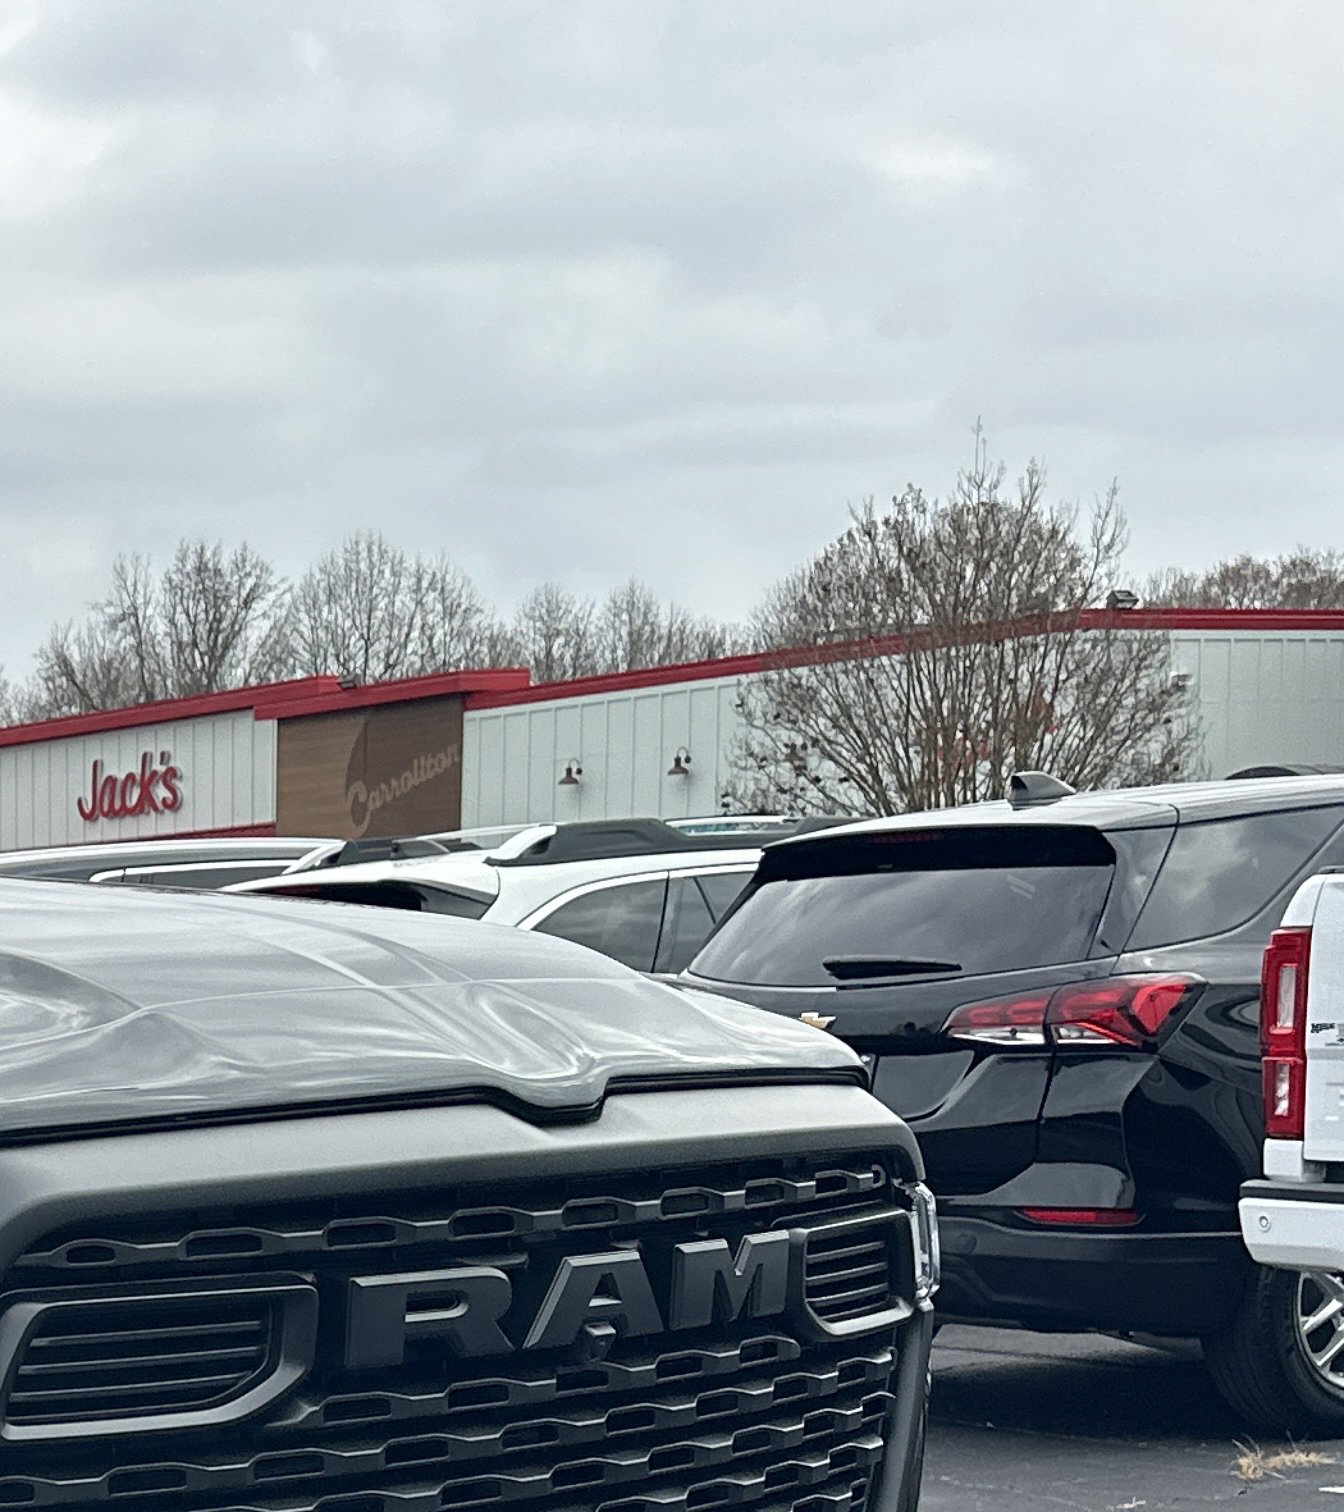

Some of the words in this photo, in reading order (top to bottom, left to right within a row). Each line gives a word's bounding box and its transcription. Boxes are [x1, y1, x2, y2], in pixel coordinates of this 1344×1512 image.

[77, 750, 183, 822] Jack's
[346, 742, 461, 839] Carrollton
[345, 1228, 790, 1369] RAM
